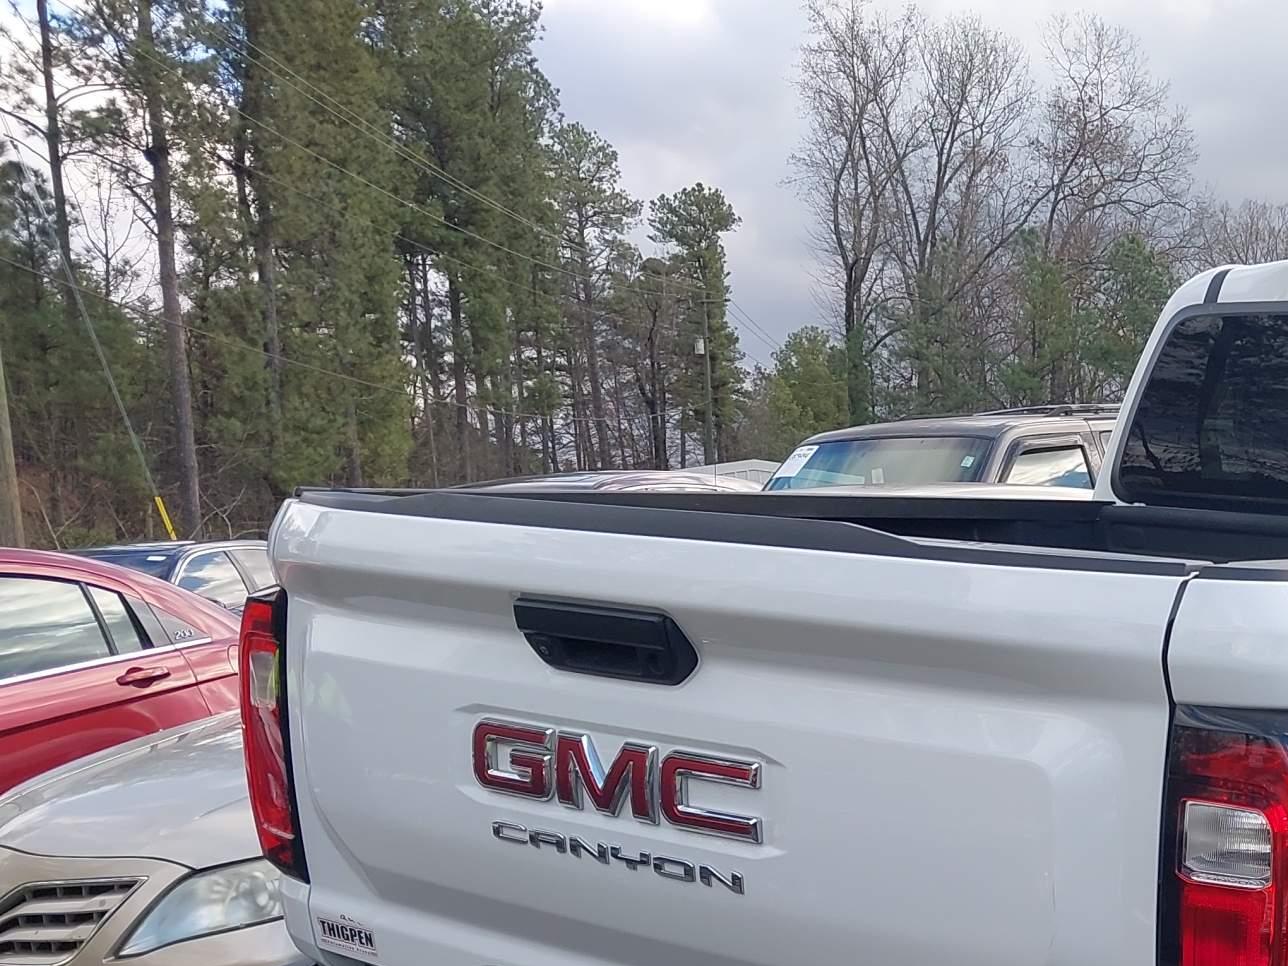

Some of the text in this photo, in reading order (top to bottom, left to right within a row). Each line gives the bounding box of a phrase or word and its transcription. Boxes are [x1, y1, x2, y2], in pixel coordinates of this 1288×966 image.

[472, 717, 763, 844] GMC
[491, 820, 745, 895] CANYON
[318, 918, 375, 948] THIGPEN
